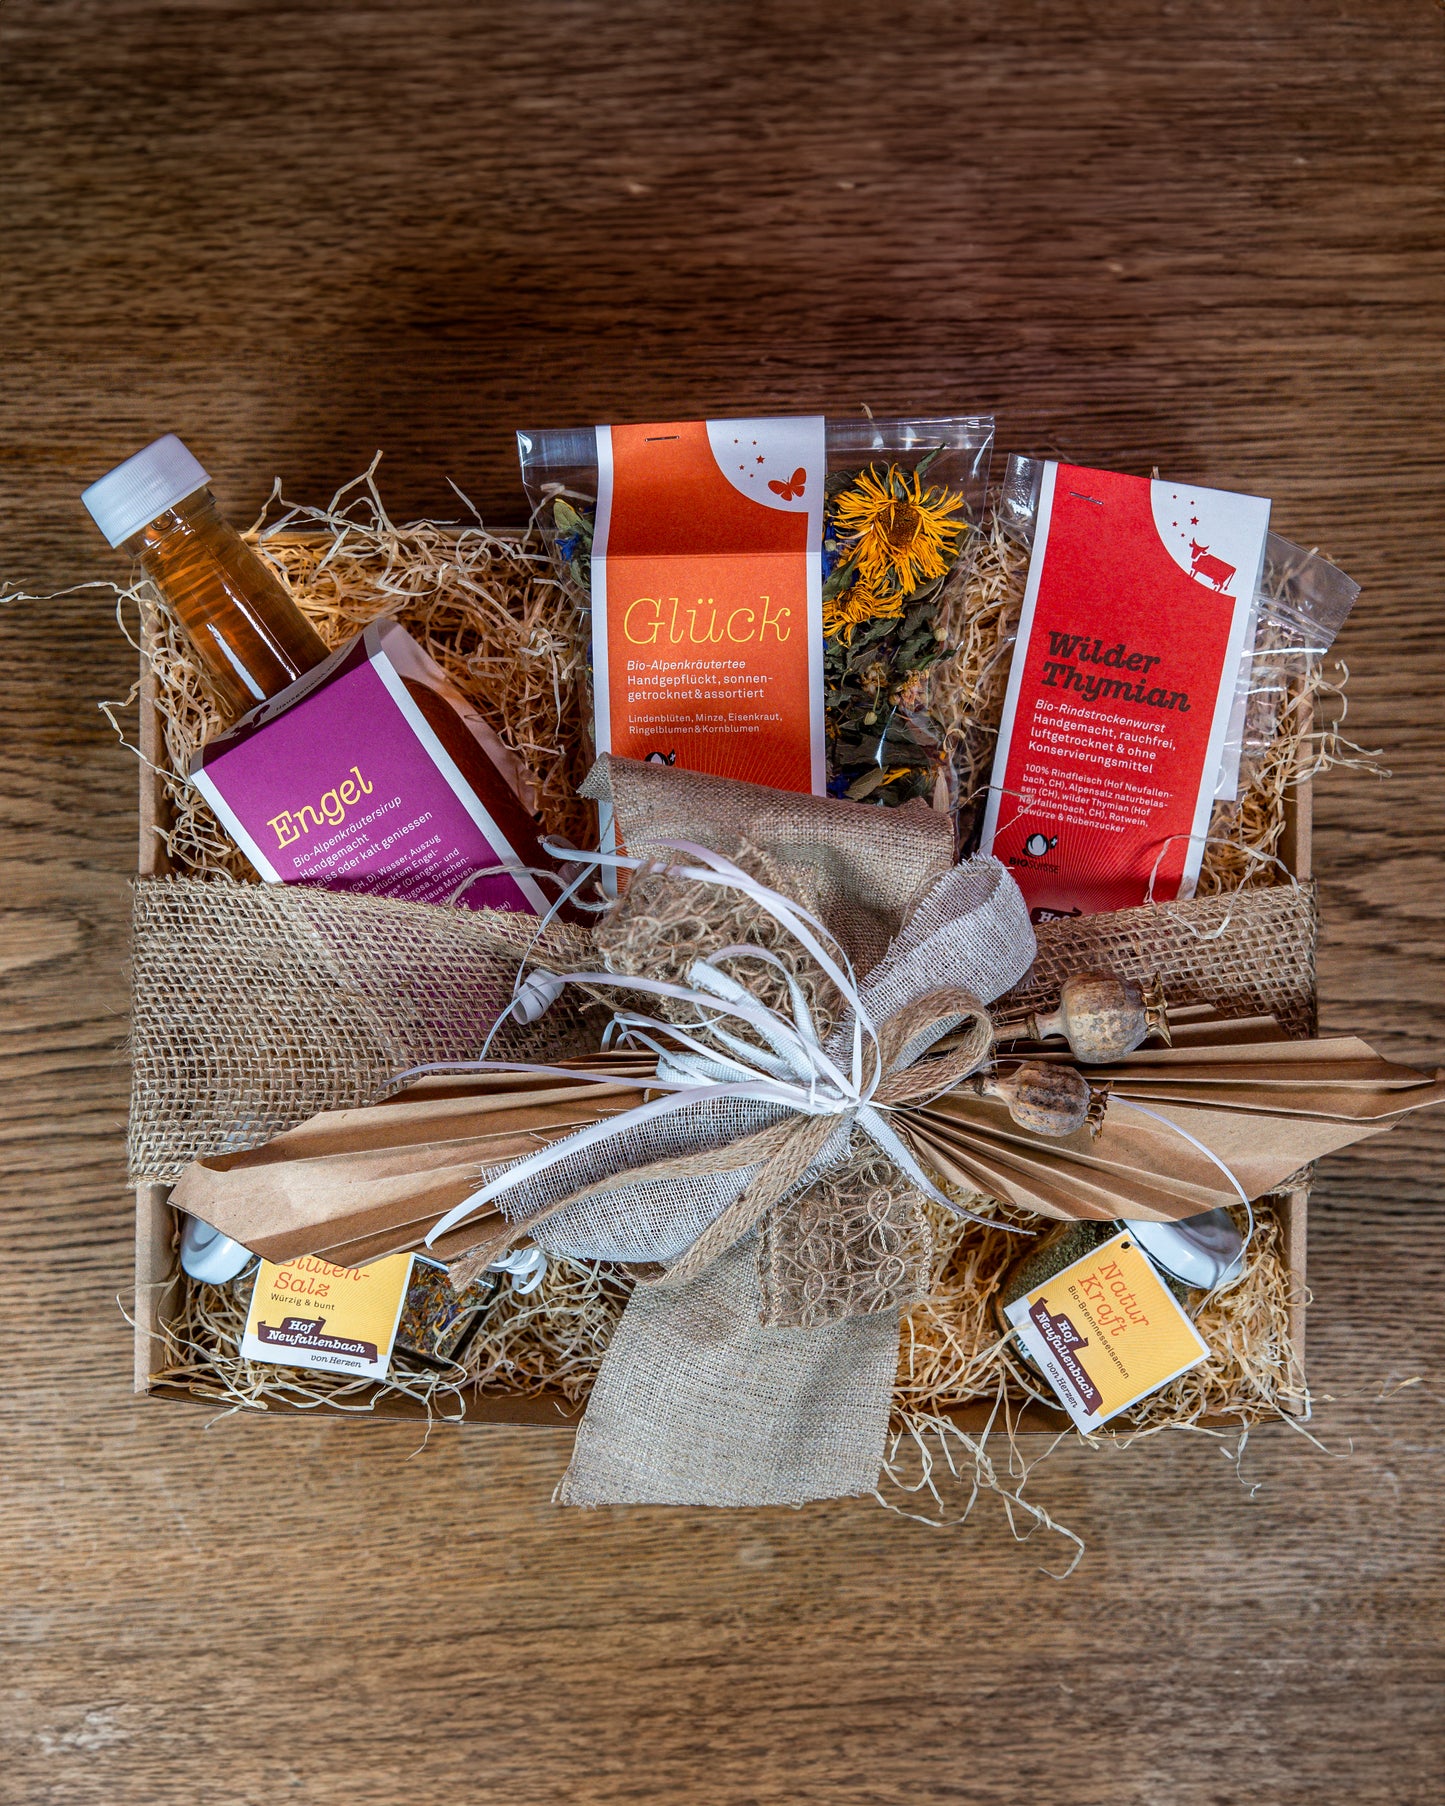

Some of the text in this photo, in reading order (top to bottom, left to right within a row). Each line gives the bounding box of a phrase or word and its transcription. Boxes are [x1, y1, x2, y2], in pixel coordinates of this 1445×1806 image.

[624, 596, 791, 644] Glück
[627, 659, 746, 672] Bio-Alpenkräutertee
[1048, 630, 1160, 674] Wilder
[628, 675, 773, 687] Handgepflückt, sonnen-
[628, 688, 764, 702] getrocknet & assortiert
[1041, 661, 1191, 713] Thymian
[628, 712, 783, 723] Lindenblüten, Minze, Eisenkraut,
[629, 725, 693, 736] Ringelblumen
[702, 724, 760, 733] Kornblumen
[1033, 713, 1176, 751] Handgemacht, rauchfrei,
[1035, 699, 1166, 733] Bio-Rindstrockenwurst
[1028, 741, 1153, 774] Konservierungsmittel
[1031, 726, 1157, 760] luftgetrocknet & ohne
[1023, 774, 1168, 808] bach, CH), Alpensalz naturbelas-
[1025, 764, 1173, 799] 100% Rindfleisch (Hof Neufallen-
[266, 766, 374, 850] Engel
[1019, 794, 1148, 827] Neufallenbach, CH), Rotwein,
[1021, 786, 1151, 816] sen (CH), wilder Thymian (Hof
[293, 795, 402, 868] Bio-Alpenkräutersirup
[1057, 813, 1064, 821] &
[1066, 814, 1126, 833] Rübenzucker
[300, 833, 370, 879] Handgemacht
[337, 856, 361, 875] oder
[360, 843, 382, 860] kalt
[381, 810, 433, 851] geniessen
[378, 854, 411, 877] Wasser,
[410, 834, 441, 857] Auszug
[411, 849, 439, 868] Engel-
[400, 881, 434, 902] Rugosa,
[431, 856, 469, 882] Drachen-
[402, 861, 442, 888] (Orangen-
[443, 848, 460, 863] und
[420, 886, 444, 903] blaue
[443, 867, 477, 890] Malven,
[273, 1271, 330, 1297] Salz
[1098, 1261, 1151, 1327] Natur
[271, 1292, 302, 1306] Würzig
[314, 1300, 335, 1311] bunt
[1078, 1273, 1126, 1337] Kraft
[267, 1330, 366, 1354] Neufallenbach
[288, 1320, 316, 1333] Hof
[1056, 1319, 1079, 1344] Hof
[1068, 1285, 1130, 1380] Bio-Brennnesselsamen
[311, 1355, 362, 1368] von Herzen
[1035, 1311, 1094, 1400] Neufallenbach
[1046, 1362, 1078, 1408] von Herzen
